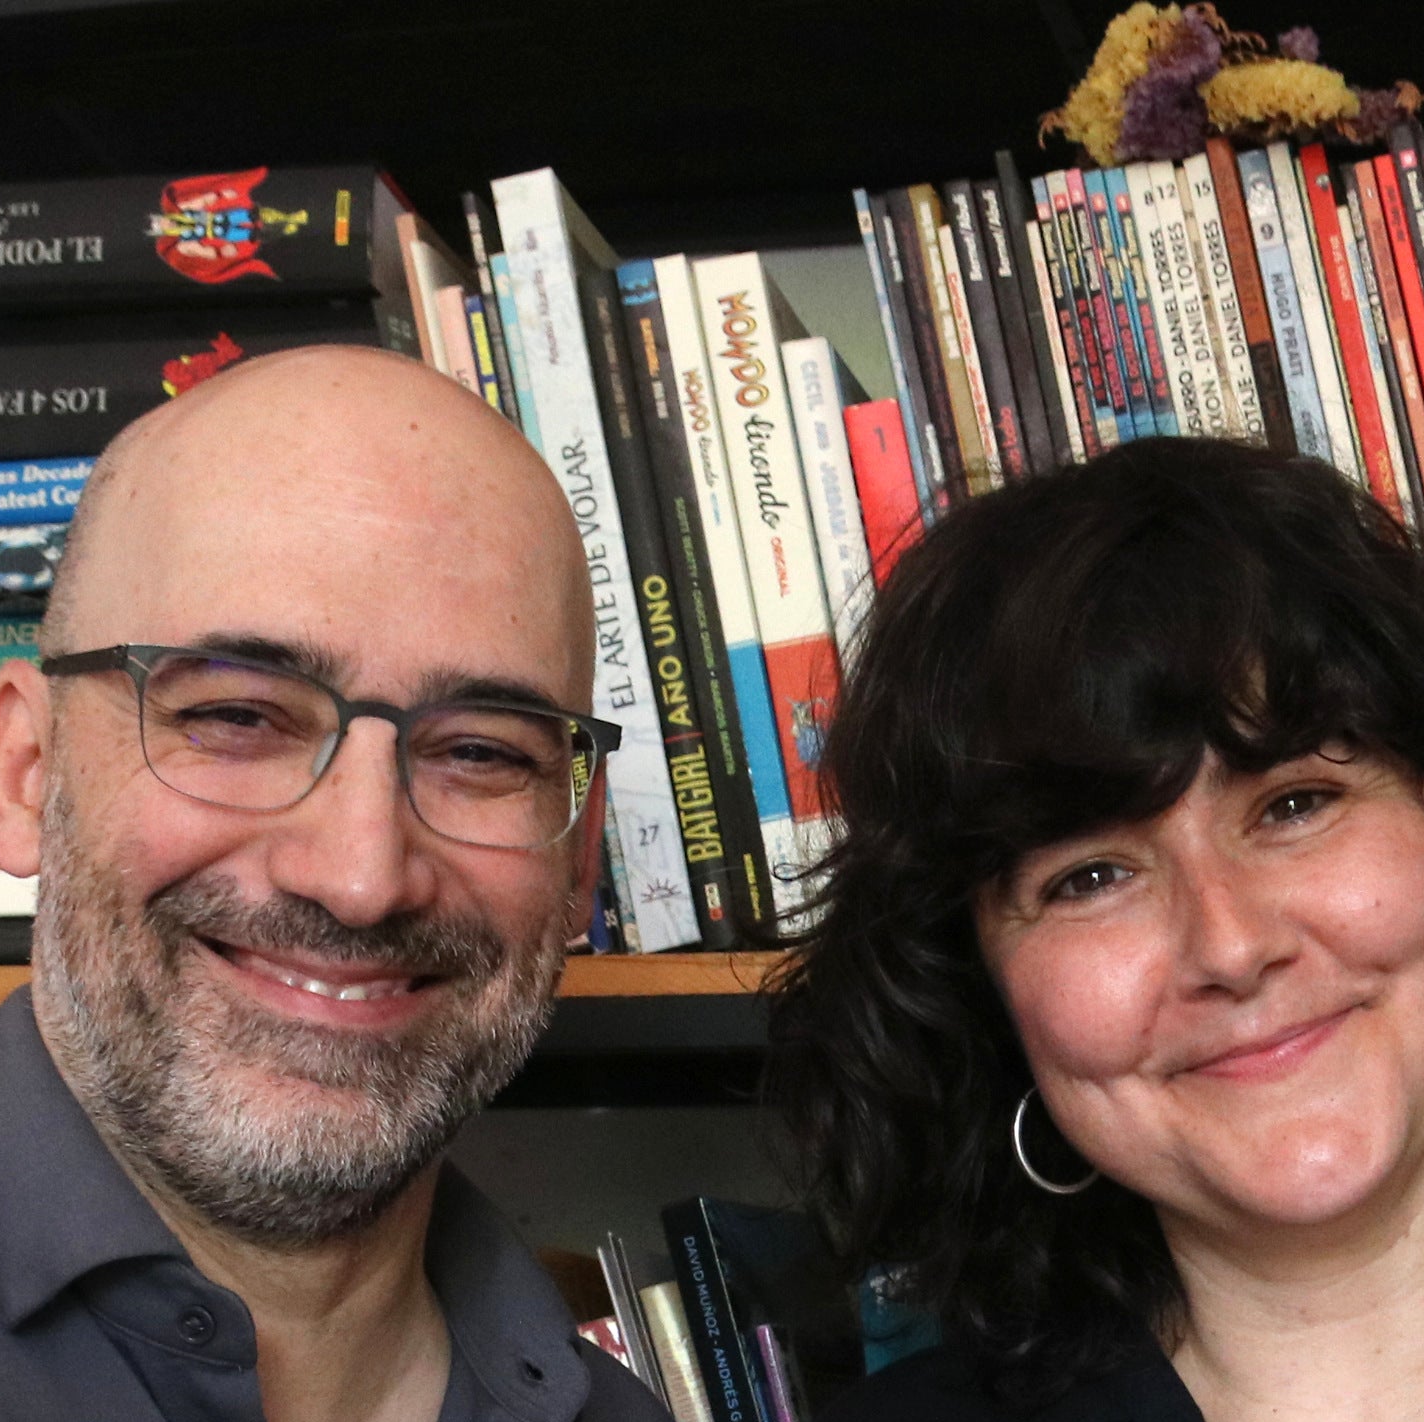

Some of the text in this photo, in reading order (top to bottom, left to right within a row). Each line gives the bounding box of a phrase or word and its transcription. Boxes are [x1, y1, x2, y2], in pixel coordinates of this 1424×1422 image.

[1156, 183, 1176, 201] 12
[1195, 180, 1212, 198] 15
[67, 235, 104, 262] EL
[1149, 227, 1187, 356] DANIEL TORRES
[1167, 220, 1209, 361] DANIEL TORRES
[1203, 218, 1245, 357] DANIEL TORRES
[710, 289, 771, 410] MONDO
[1269, 272, 1305, 378] HUGO PRATT
[31, 389, 47, 413] 4
[51, 386, 107, 412] LOS
[560, 439, 635, 708] EL ARTE DE VOLAR
[641, 572, 723, 863] BATGIRL AÑO UNO
[639, 824, 660, 846] 27
[683, 1236, 704, 1282] DAVID
[697, 1284, 719, 1338] MUÑOZ
[714, 1346, 737, 1408] ANDRÉS
